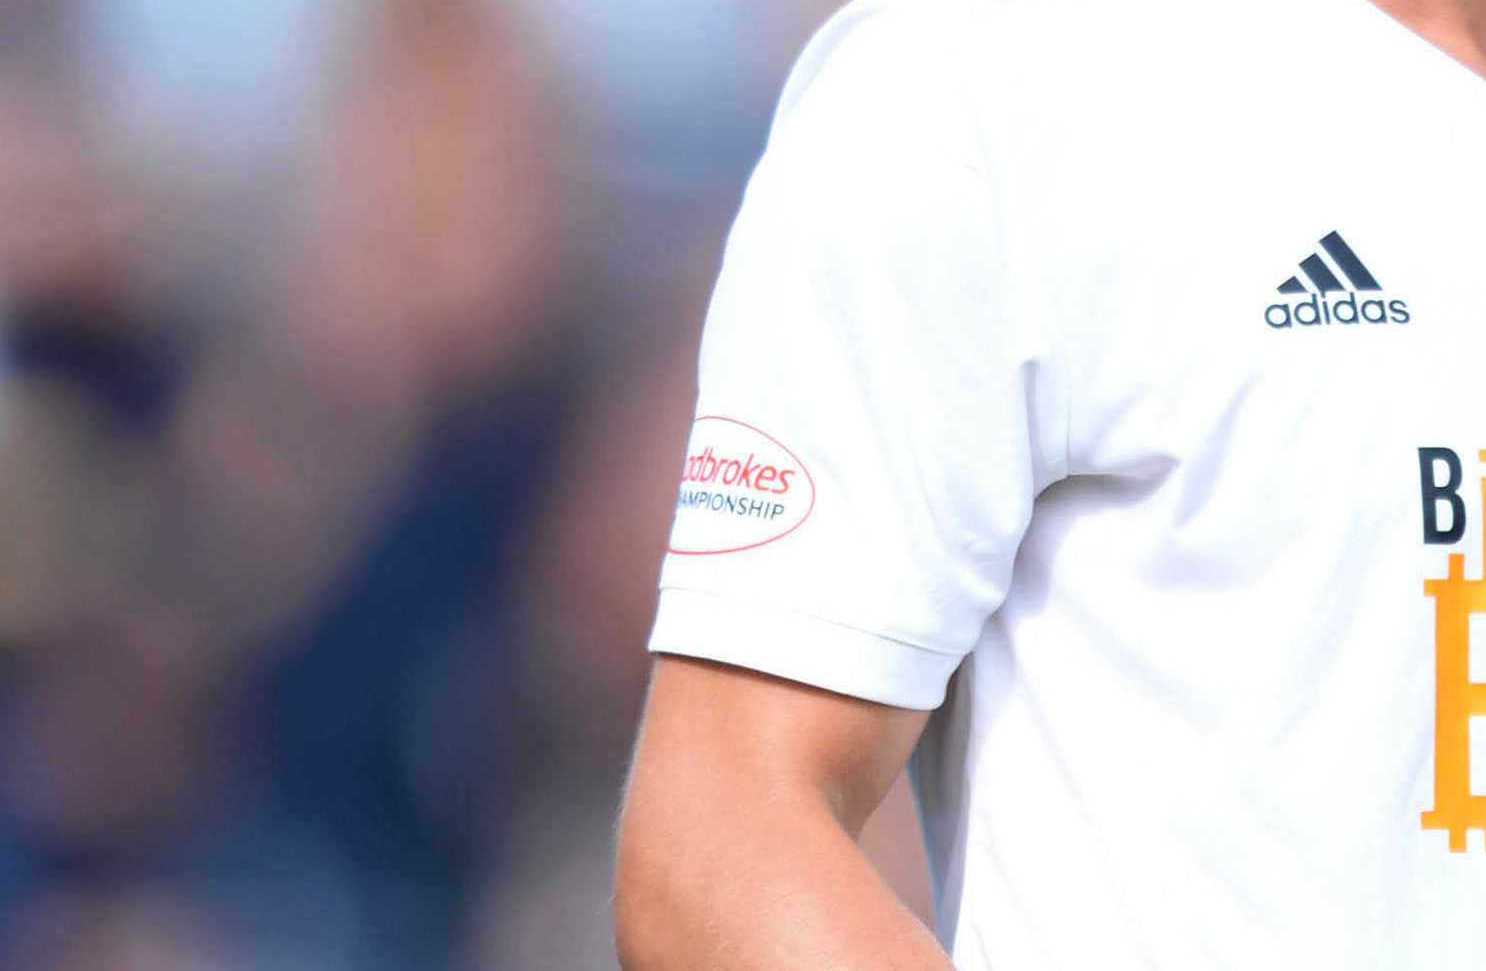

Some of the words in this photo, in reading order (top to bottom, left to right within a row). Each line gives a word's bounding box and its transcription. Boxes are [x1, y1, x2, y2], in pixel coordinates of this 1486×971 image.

[1264, 292, 1410, 329] adidas
[681, 447, 797, 495] adbrokes
[678, 489, 785, 520] AMPIONSHIP
